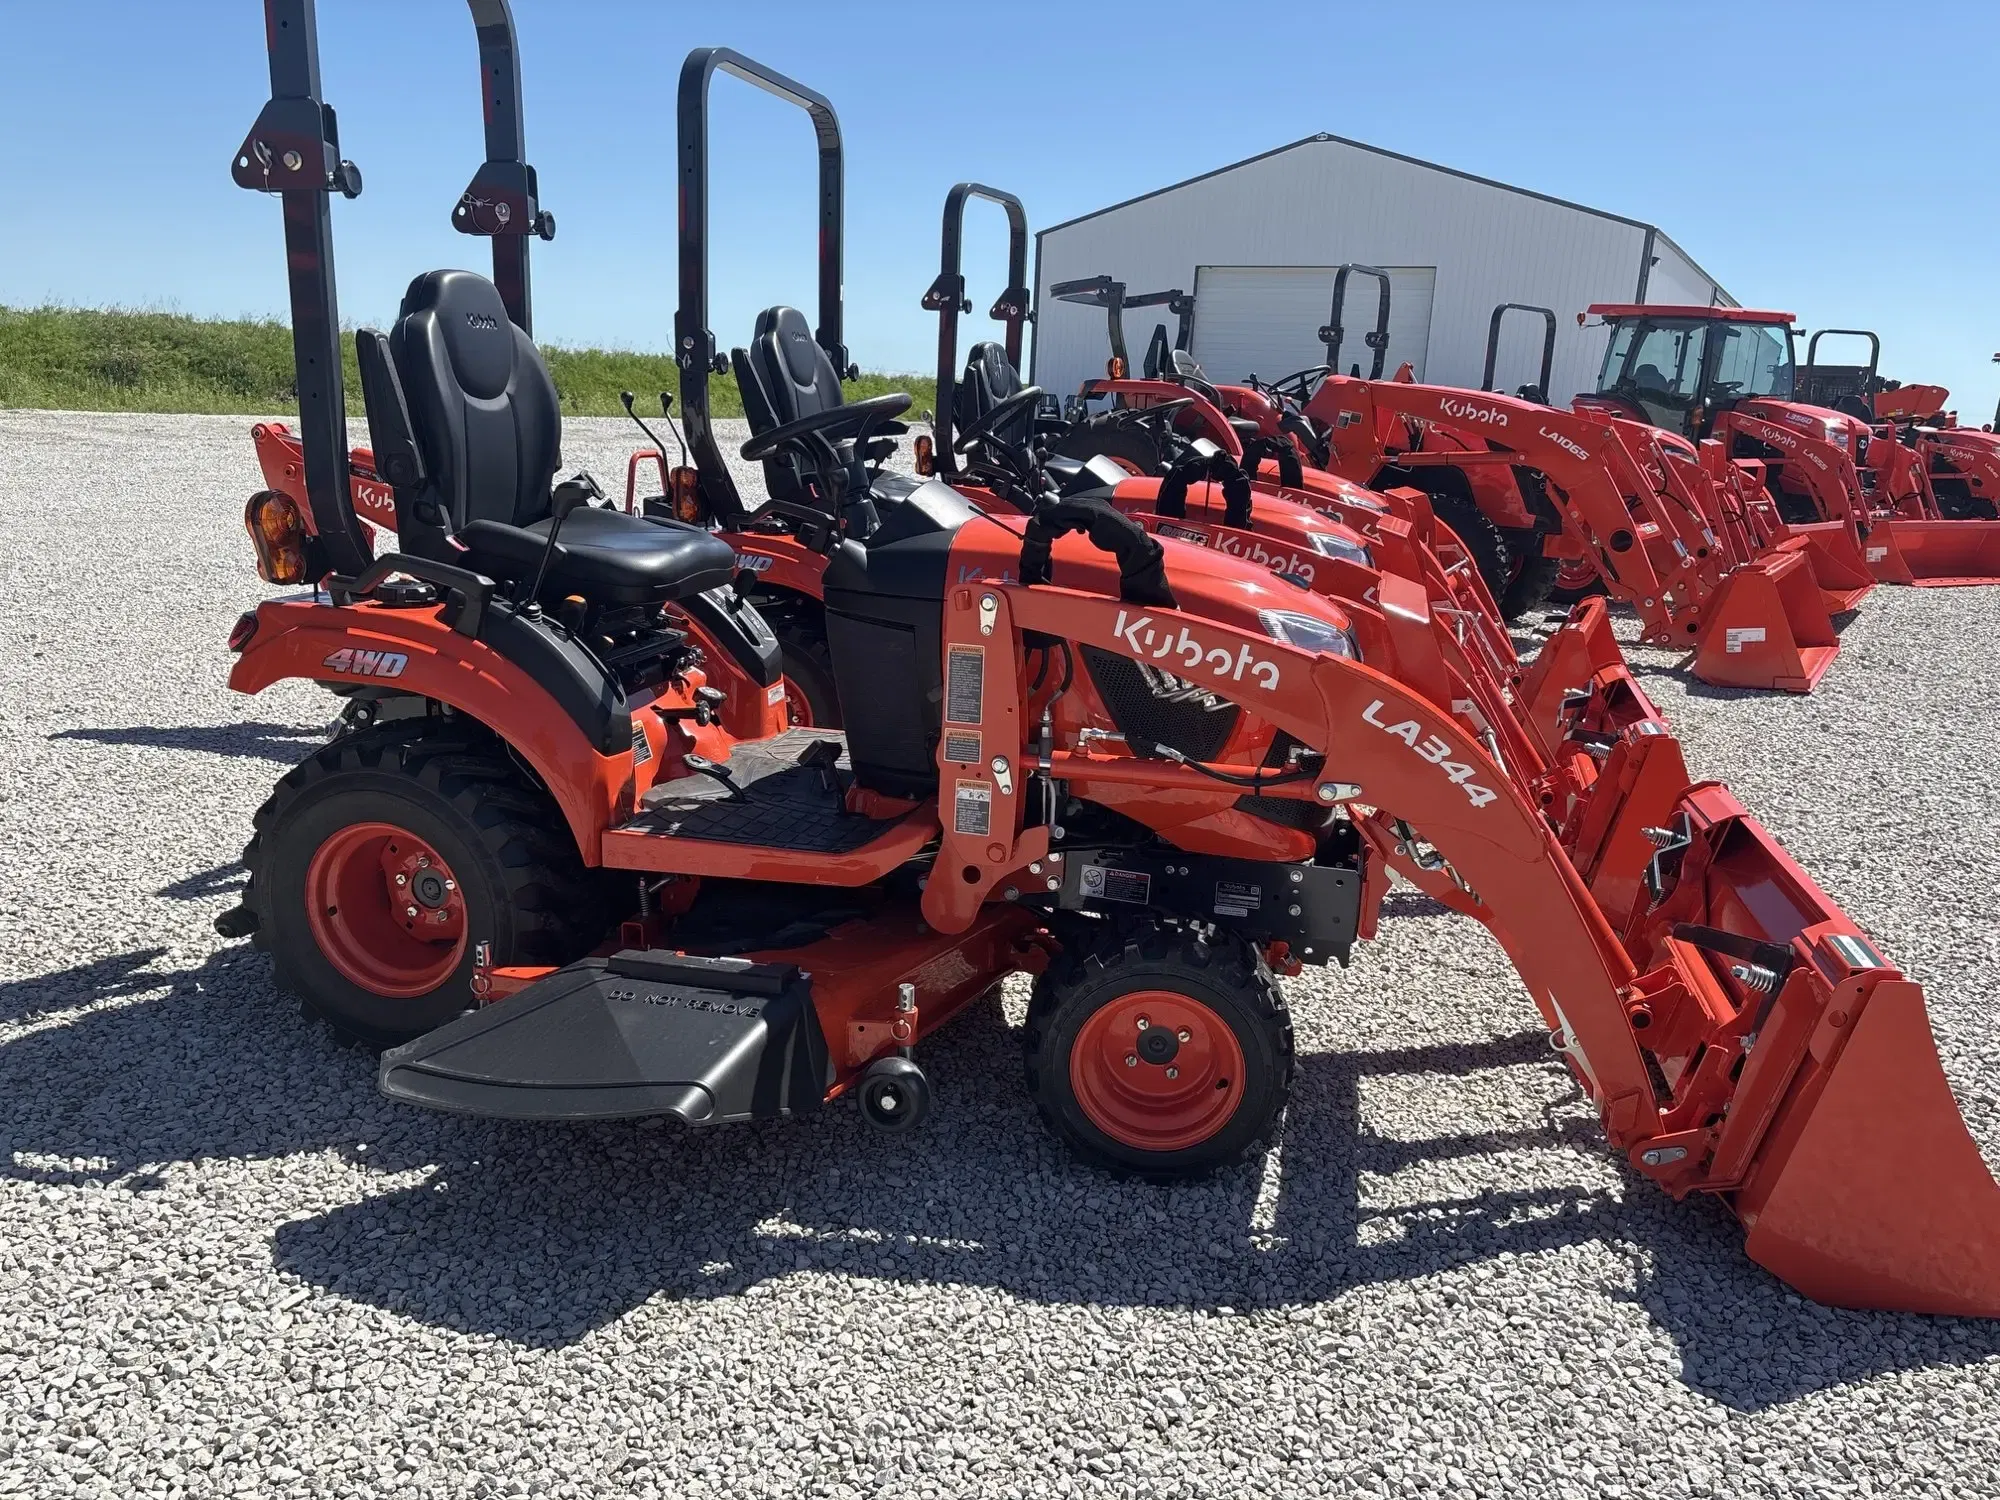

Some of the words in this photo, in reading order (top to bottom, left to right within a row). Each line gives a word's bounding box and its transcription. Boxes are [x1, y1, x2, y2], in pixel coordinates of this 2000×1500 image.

[1439, 398, 1508, 427] Kubota
[1539, 426, 1590, 461] LA1065
[1761, 425, 1797, 449] Kubota
[1950, 447, 1975, 461] Kubota
[357, 484, 396, 512] Kub
[735, 553, 773, 572] WD
[1214, 532, 1316, 583] Kubota
[322, 647, 409, 678] 4WD
[1113, 610, 1280, 691] Kubota
[1361, 699, 1498, 809] LA344
[1114, 871, 1137, 880] DANGER
[607, 990, 636, 1001] DO
[643, 994, 682, 1008] NOT
[684, 999, 761, 1019] REMOVE
